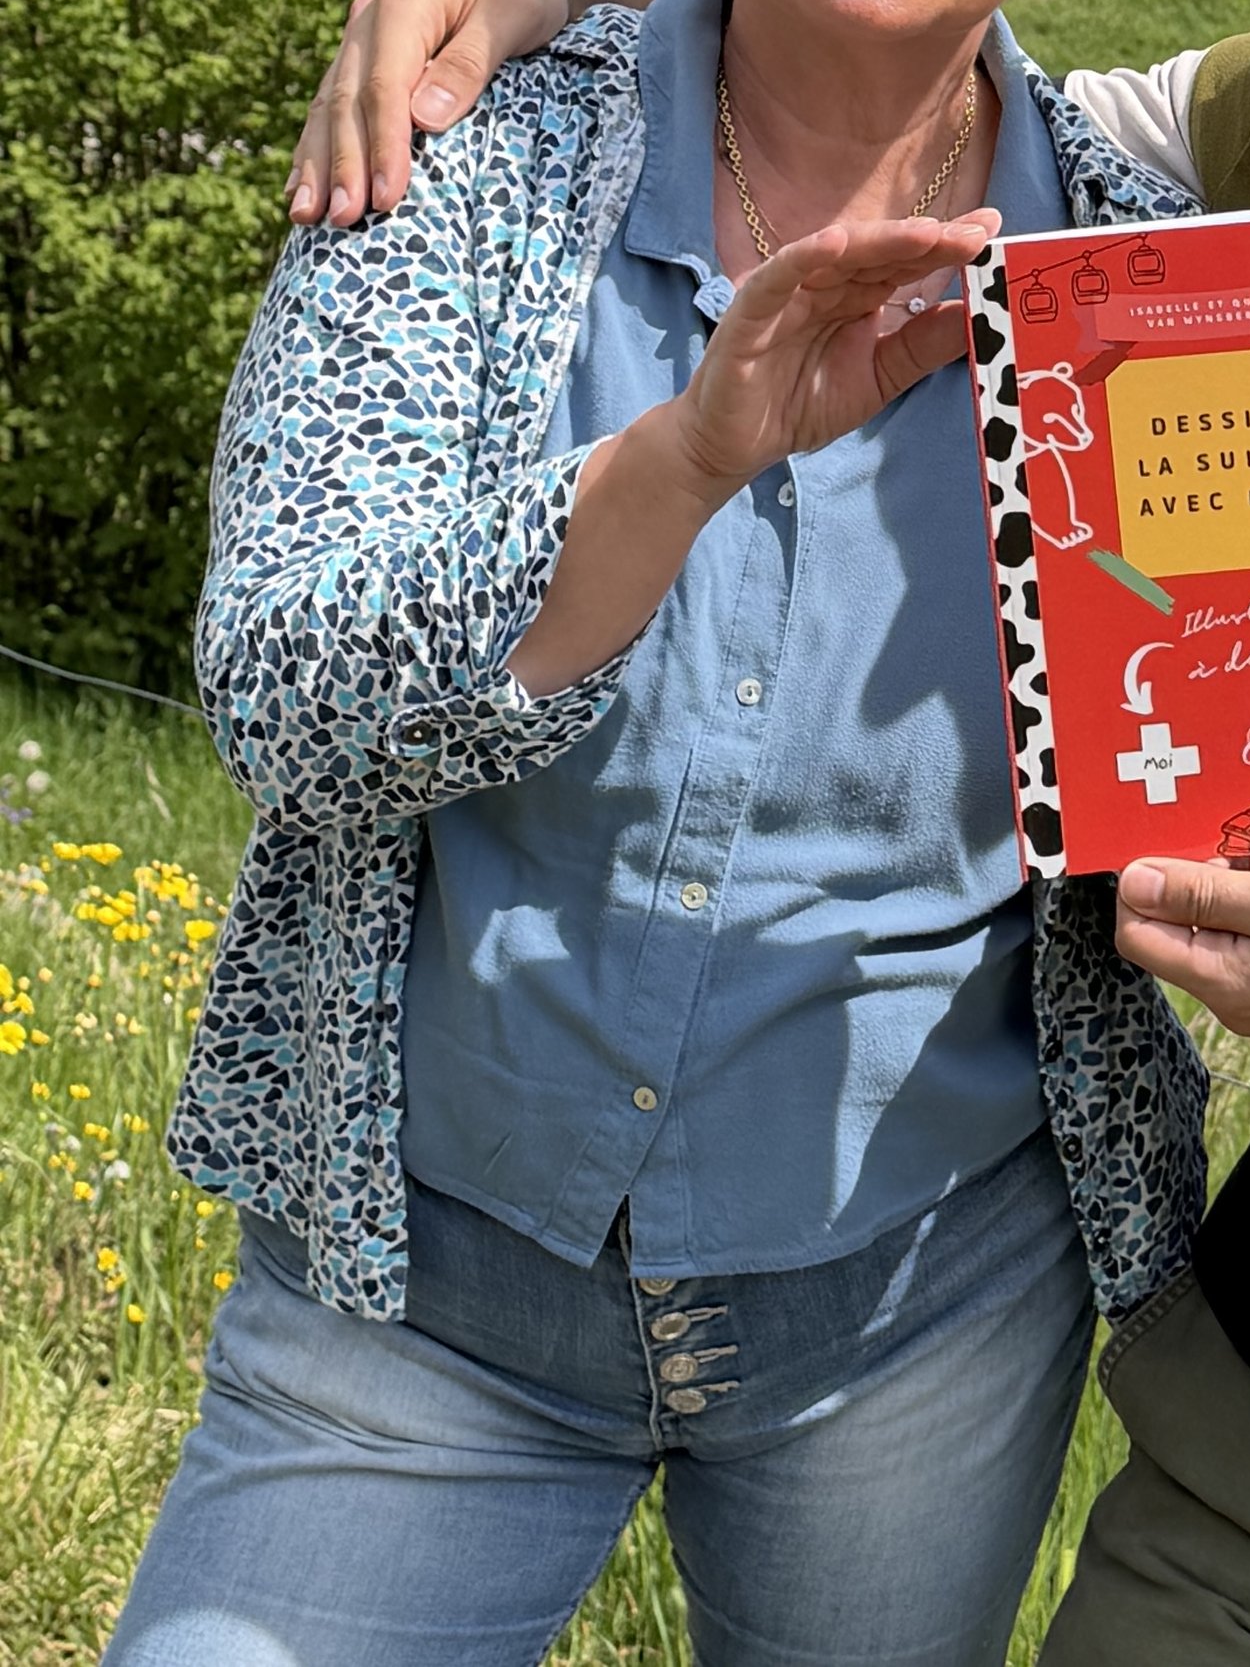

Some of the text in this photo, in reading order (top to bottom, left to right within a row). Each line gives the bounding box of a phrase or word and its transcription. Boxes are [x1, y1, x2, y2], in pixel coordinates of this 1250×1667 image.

[1208, 299, 1224, 311] ET
[1147, 318, 1175, 328] VAN
[1138, 456, 1174, 478] LA
[1139, 491, 1224, 517] AVEC
[1144, 753, 1174, 770] Moi
